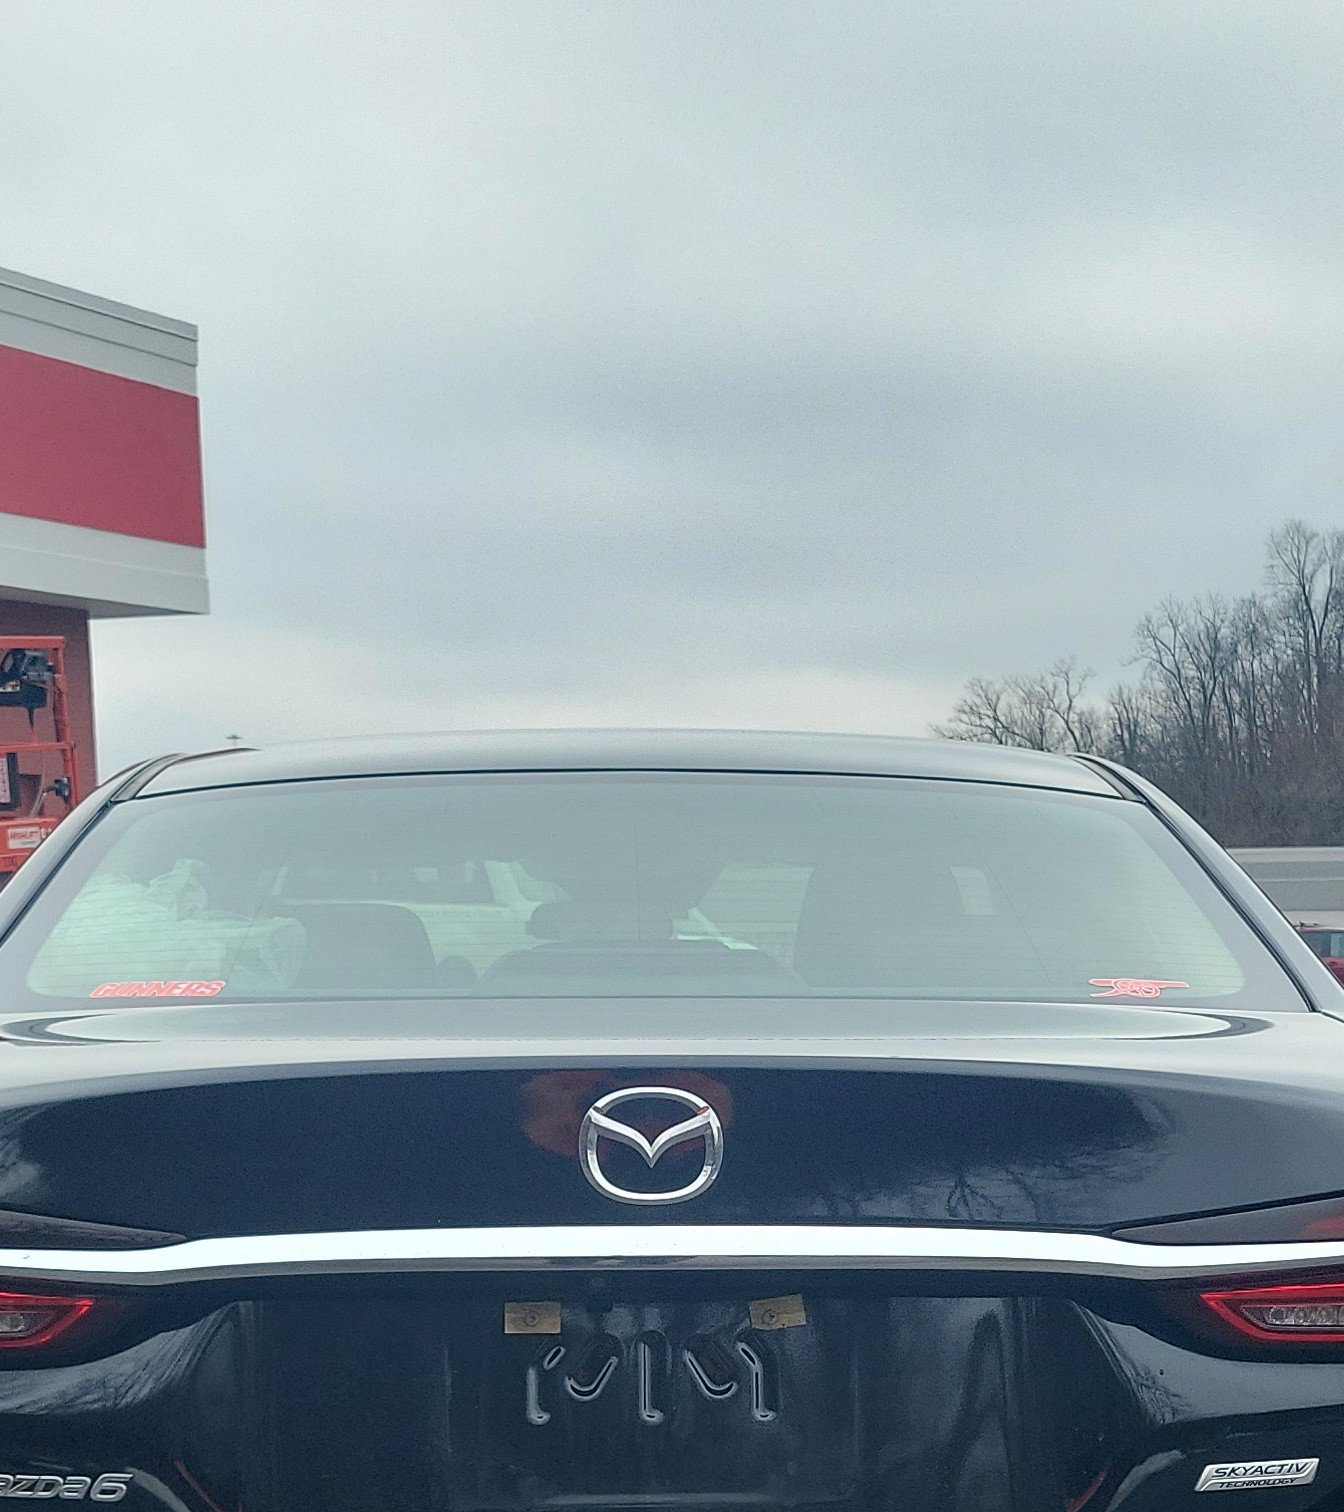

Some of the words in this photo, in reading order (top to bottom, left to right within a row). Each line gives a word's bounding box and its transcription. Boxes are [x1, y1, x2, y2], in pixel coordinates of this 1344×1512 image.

[89, 980, 227, 999] GUNNERS
[1211, 1462, 1312, 1478] SKYACTIV
[1219, 1478, 1297, 1489] TECHNOLOGY
